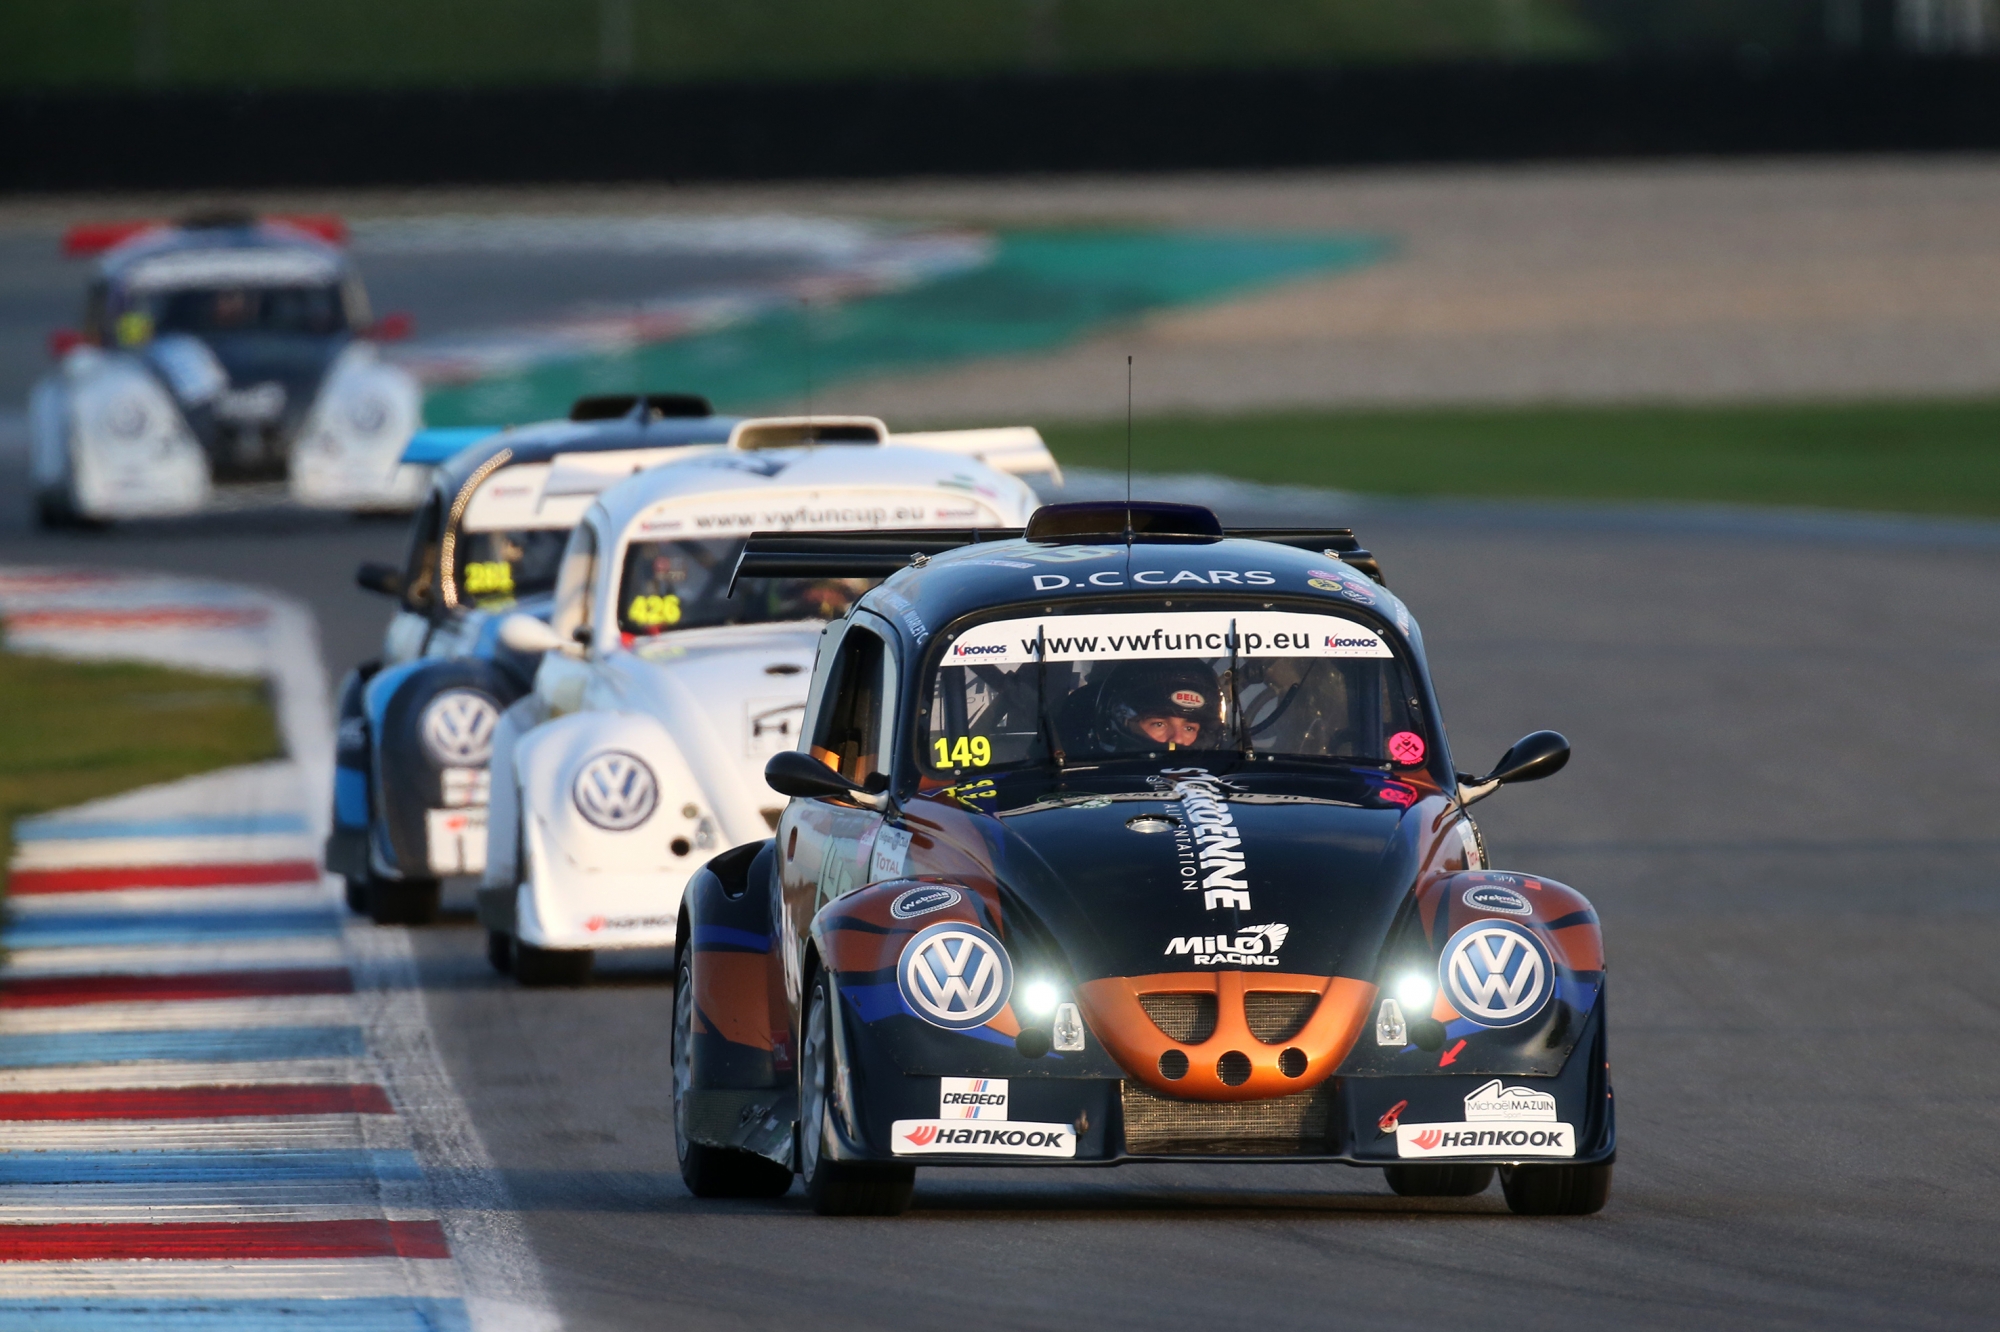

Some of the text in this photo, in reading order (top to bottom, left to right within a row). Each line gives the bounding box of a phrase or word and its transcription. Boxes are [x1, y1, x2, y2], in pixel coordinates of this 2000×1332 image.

[1133, 570, 1276, 585] CARS
[627, 595, 681, 625] 426
[1021, 628, 1310, 656] www.vwfuncup.eu
[1324, 633, 1377, 648] KRONOS
[953, 641, 1007, 656] KRONOS
[1176, 692, 1202, 703] BELL
[934, 736, 991, 768] 149
[876, 852, 900, 875] TOTAL
[1194, 953, 1279, 966] RACING
[943, 1092, 1006, 1106] CREDECO
